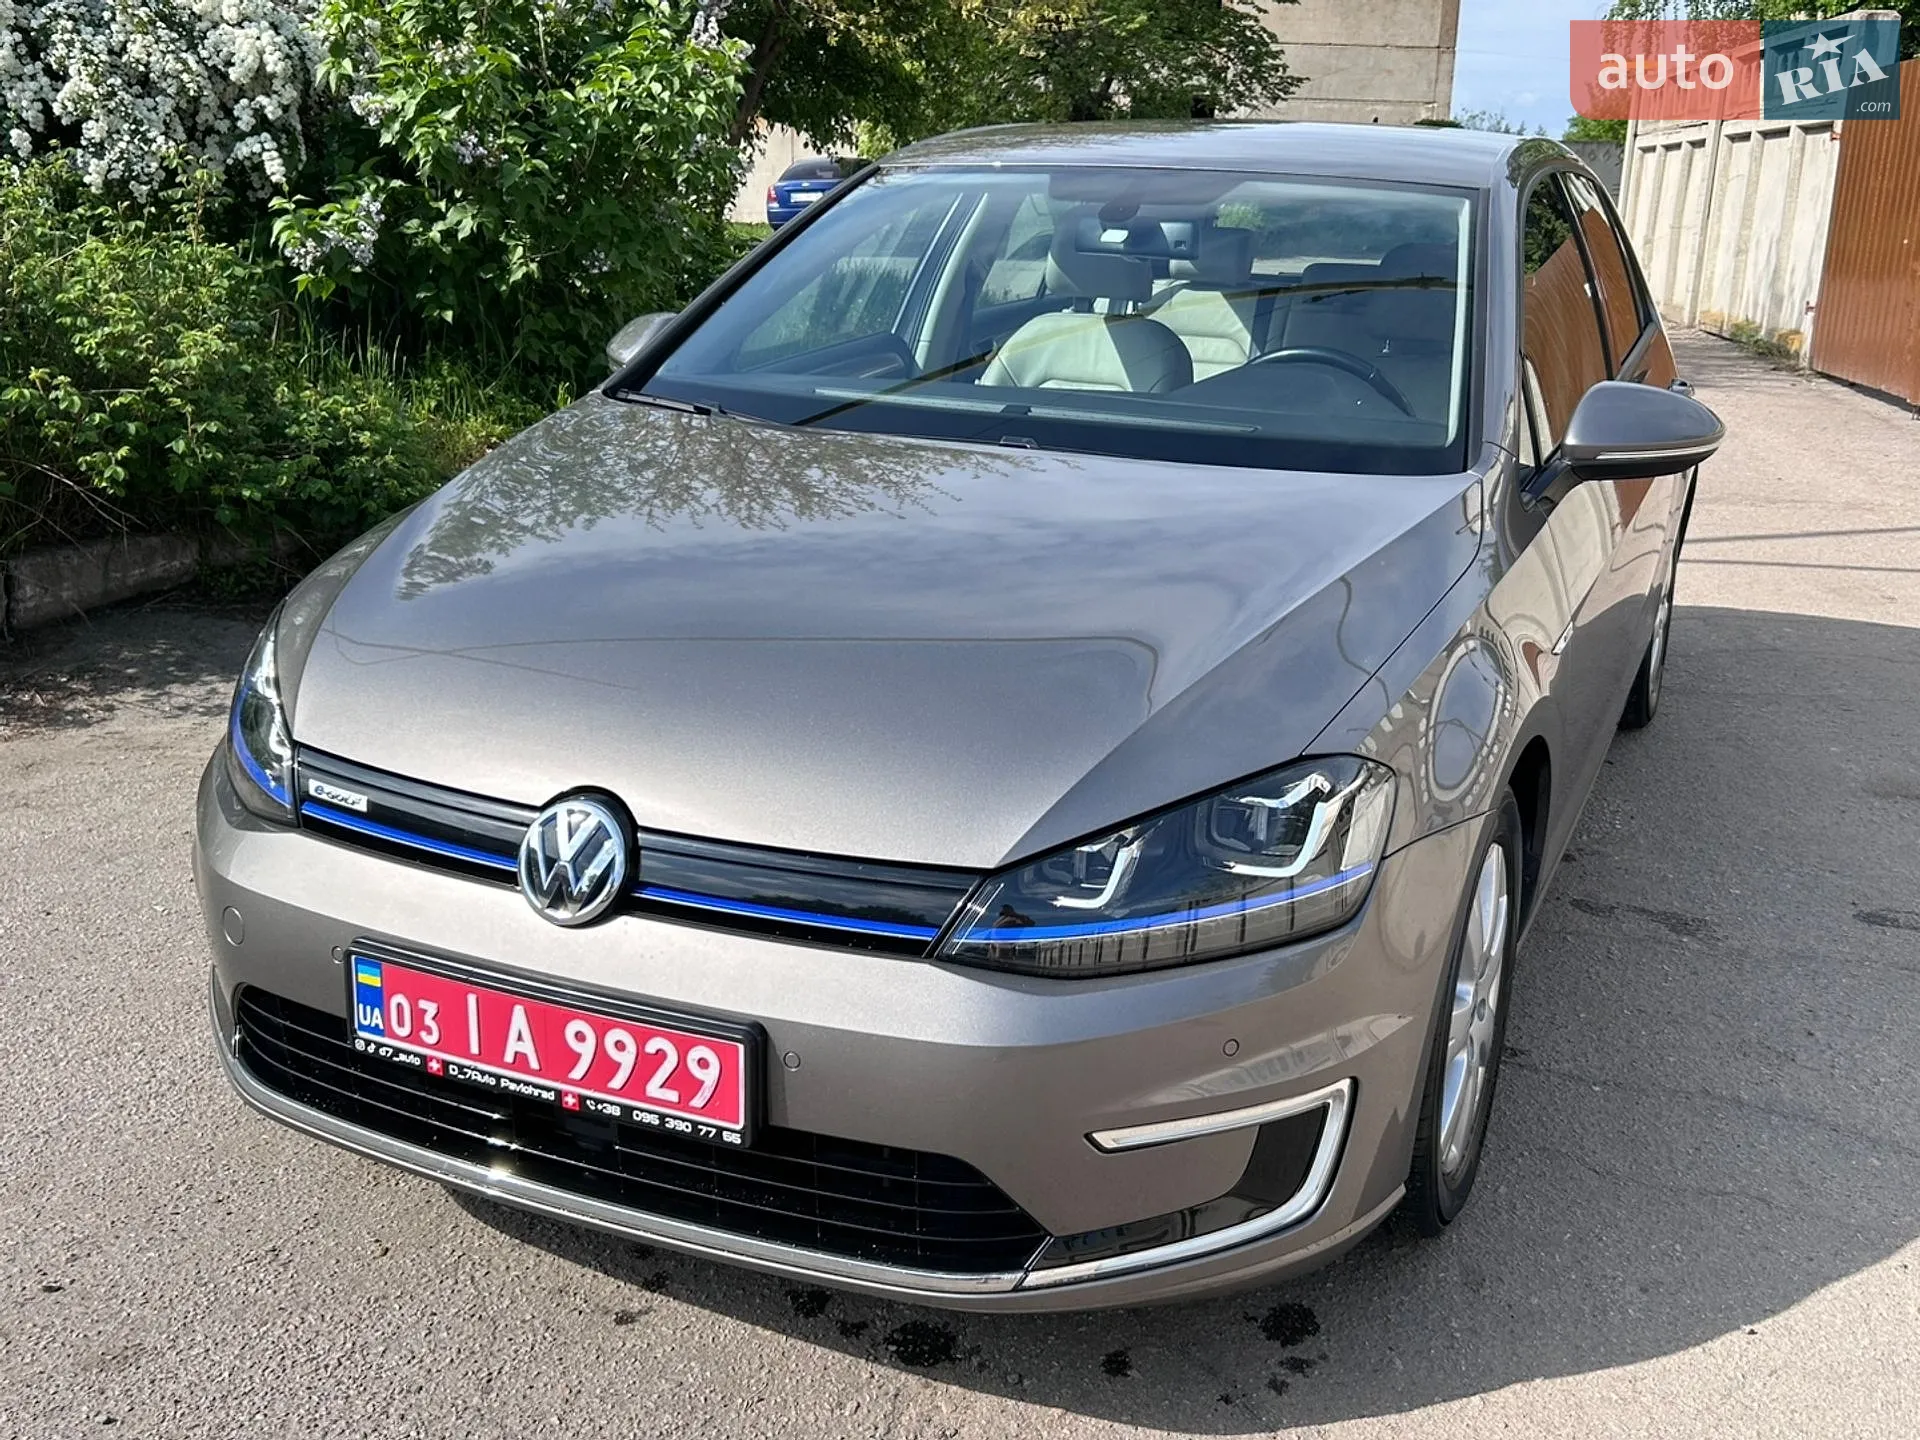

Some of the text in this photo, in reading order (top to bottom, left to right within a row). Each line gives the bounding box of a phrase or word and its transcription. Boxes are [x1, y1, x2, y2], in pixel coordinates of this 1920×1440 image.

[358, 1002, 384, 1030] UA
[389, 992, 441, 1046] 03
[564, 1018, 722, 1109] 9929
[633, 1110, 660, 1125] 095
[665, 1117, 692, 1133] 390
[697, 1125, 716, 1138] 77
